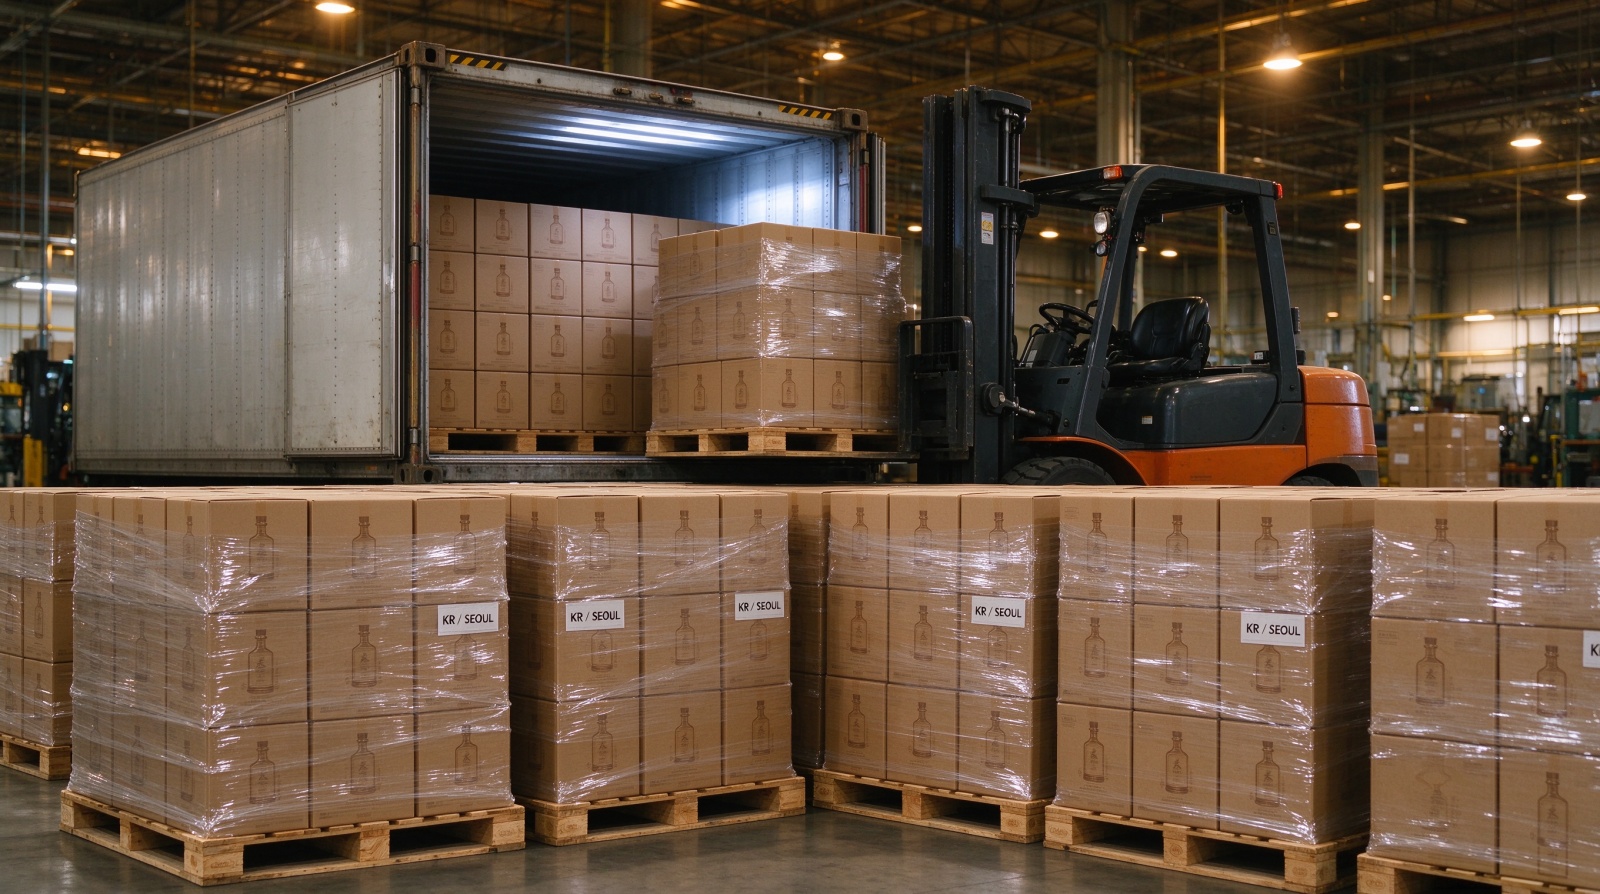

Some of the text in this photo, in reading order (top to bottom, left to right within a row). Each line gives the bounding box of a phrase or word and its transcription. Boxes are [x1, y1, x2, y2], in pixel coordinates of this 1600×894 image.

[738, 601, 781, 612] KR / SEOUL
[975, 606, 1022, 618] KR / SEOUL
[442, 613, 494, 625] KR / SEOUL
[570, 610, 621, 622] KR / SEOUL
[1246, 623, 1301, 636] KR / SEOUL
[1590, 643, 1600, 657] K
